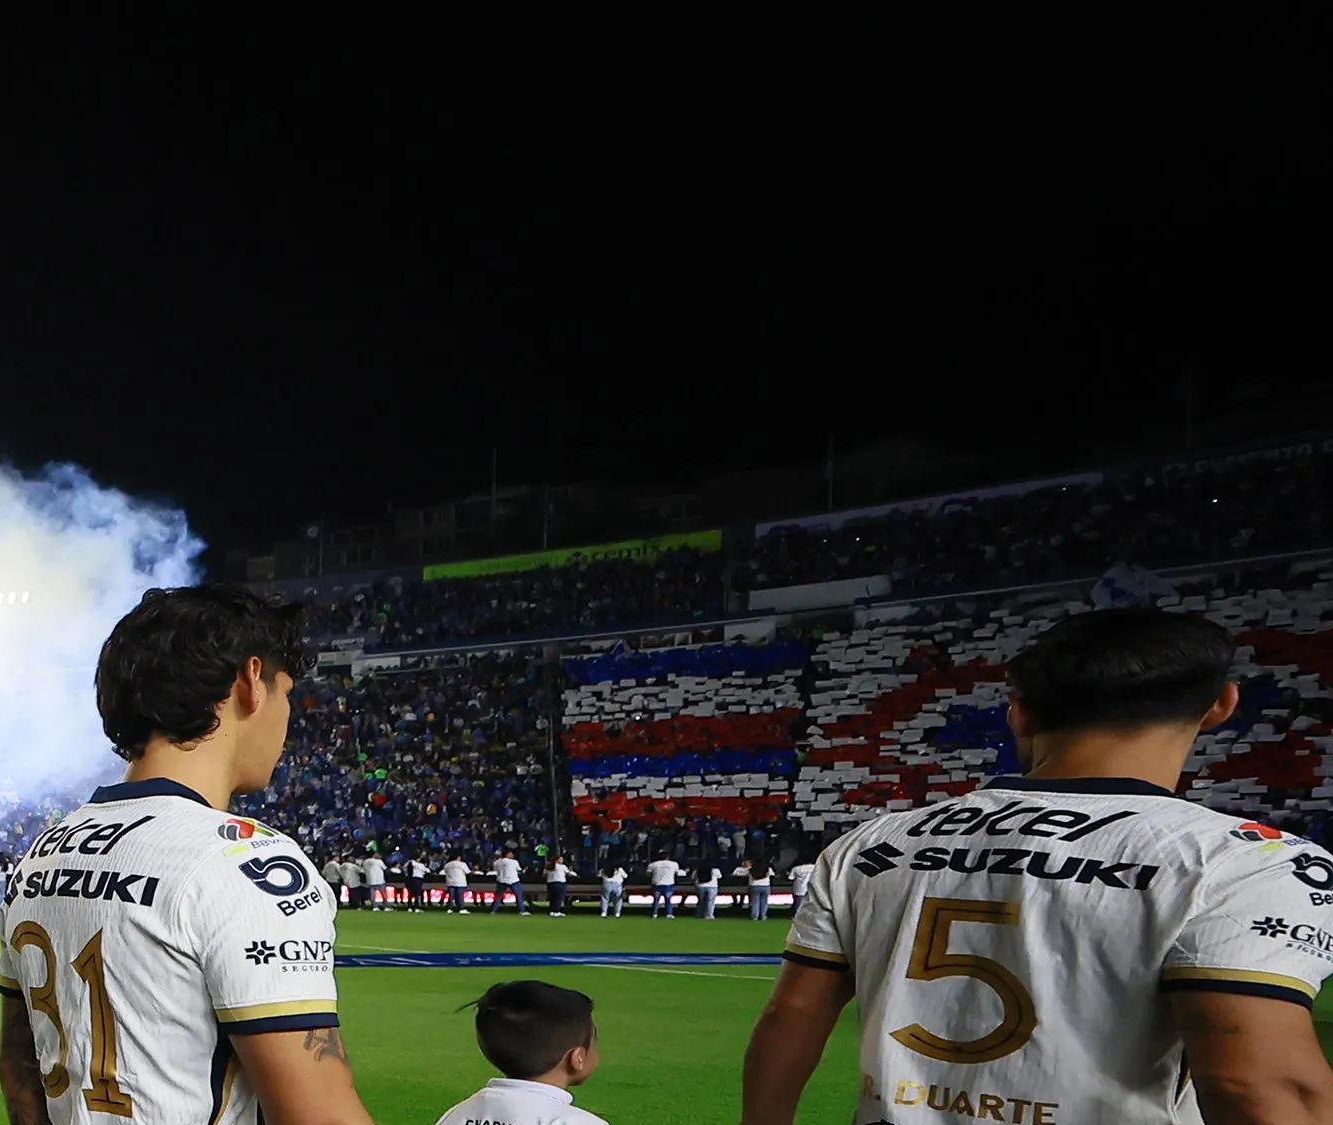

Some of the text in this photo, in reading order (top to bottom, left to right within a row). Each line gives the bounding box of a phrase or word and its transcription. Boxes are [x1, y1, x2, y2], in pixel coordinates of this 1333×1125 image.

[29, 815, 156, 859] telcel
[906, 800, 1140, 843] telcel
[23, 868, 160, 907] SUZUKI
[909, 847, 1161, 891] SUZUKI
[276, 885, 323, 917] Berel
[279, 941, 332, 961] GNP
[889, 895, 1038, 1064] 5
[10, 919, 134, 1119] 31
